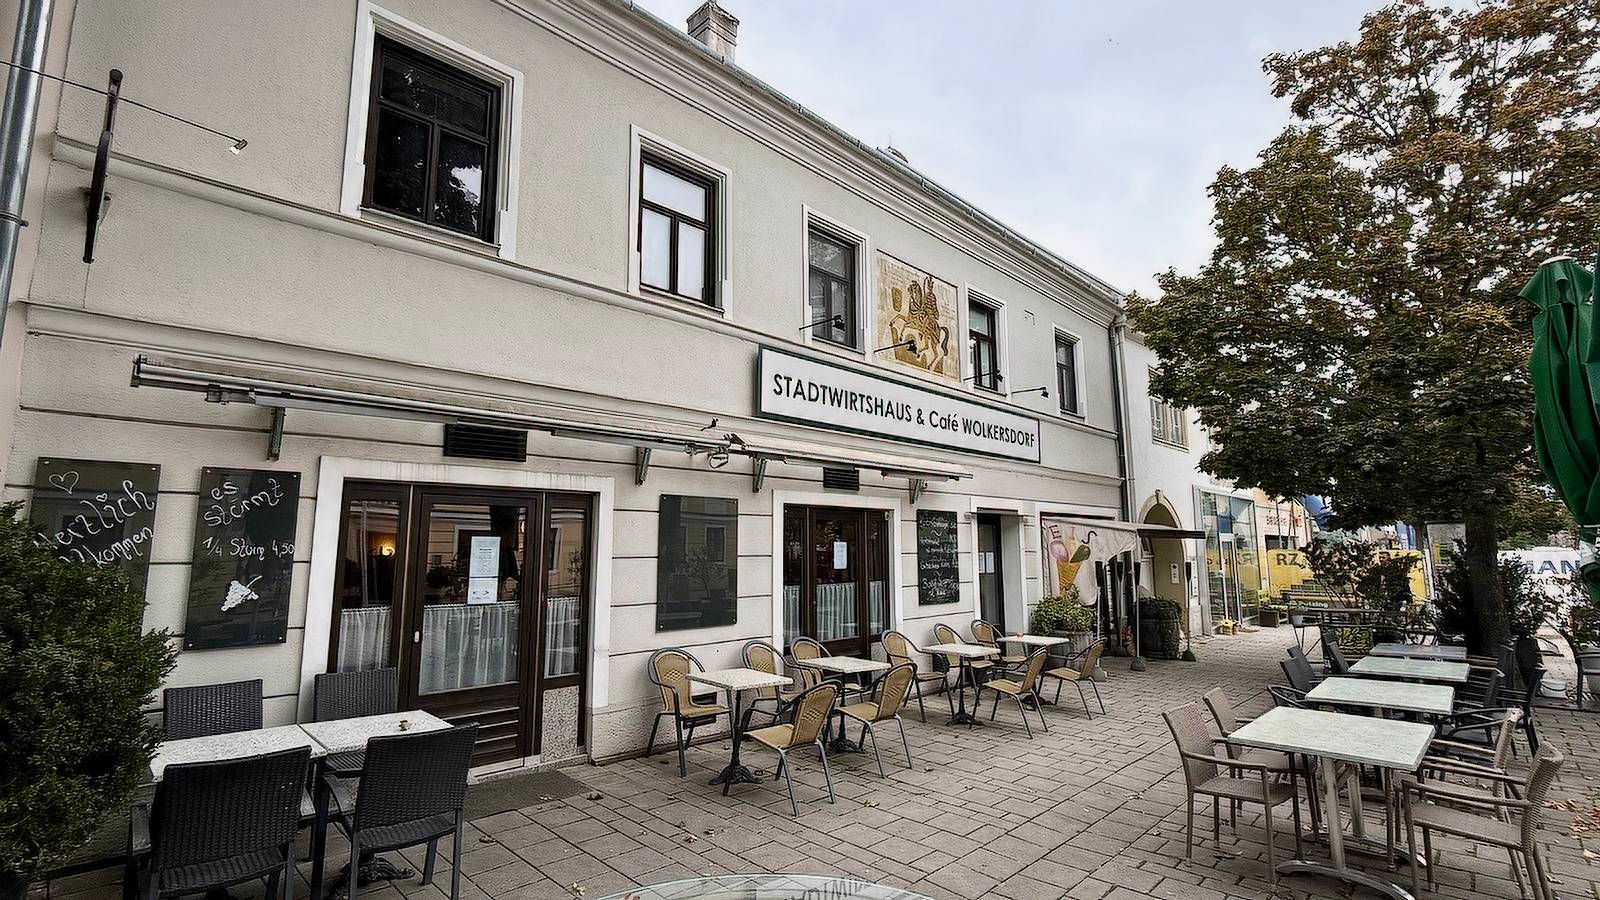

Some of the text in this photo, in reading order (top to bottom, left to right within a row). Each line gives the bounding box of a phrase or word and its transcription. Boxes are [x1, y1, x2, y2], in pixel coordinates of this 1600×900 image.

[773, 374, 1035, 448] STADTWIRTSHAUS & Café WOLKERSDORF
[211, 481, 239, 500] es
[202, 537, 222, 557] 1/4
[272, 539, 295, 558] 4,50
